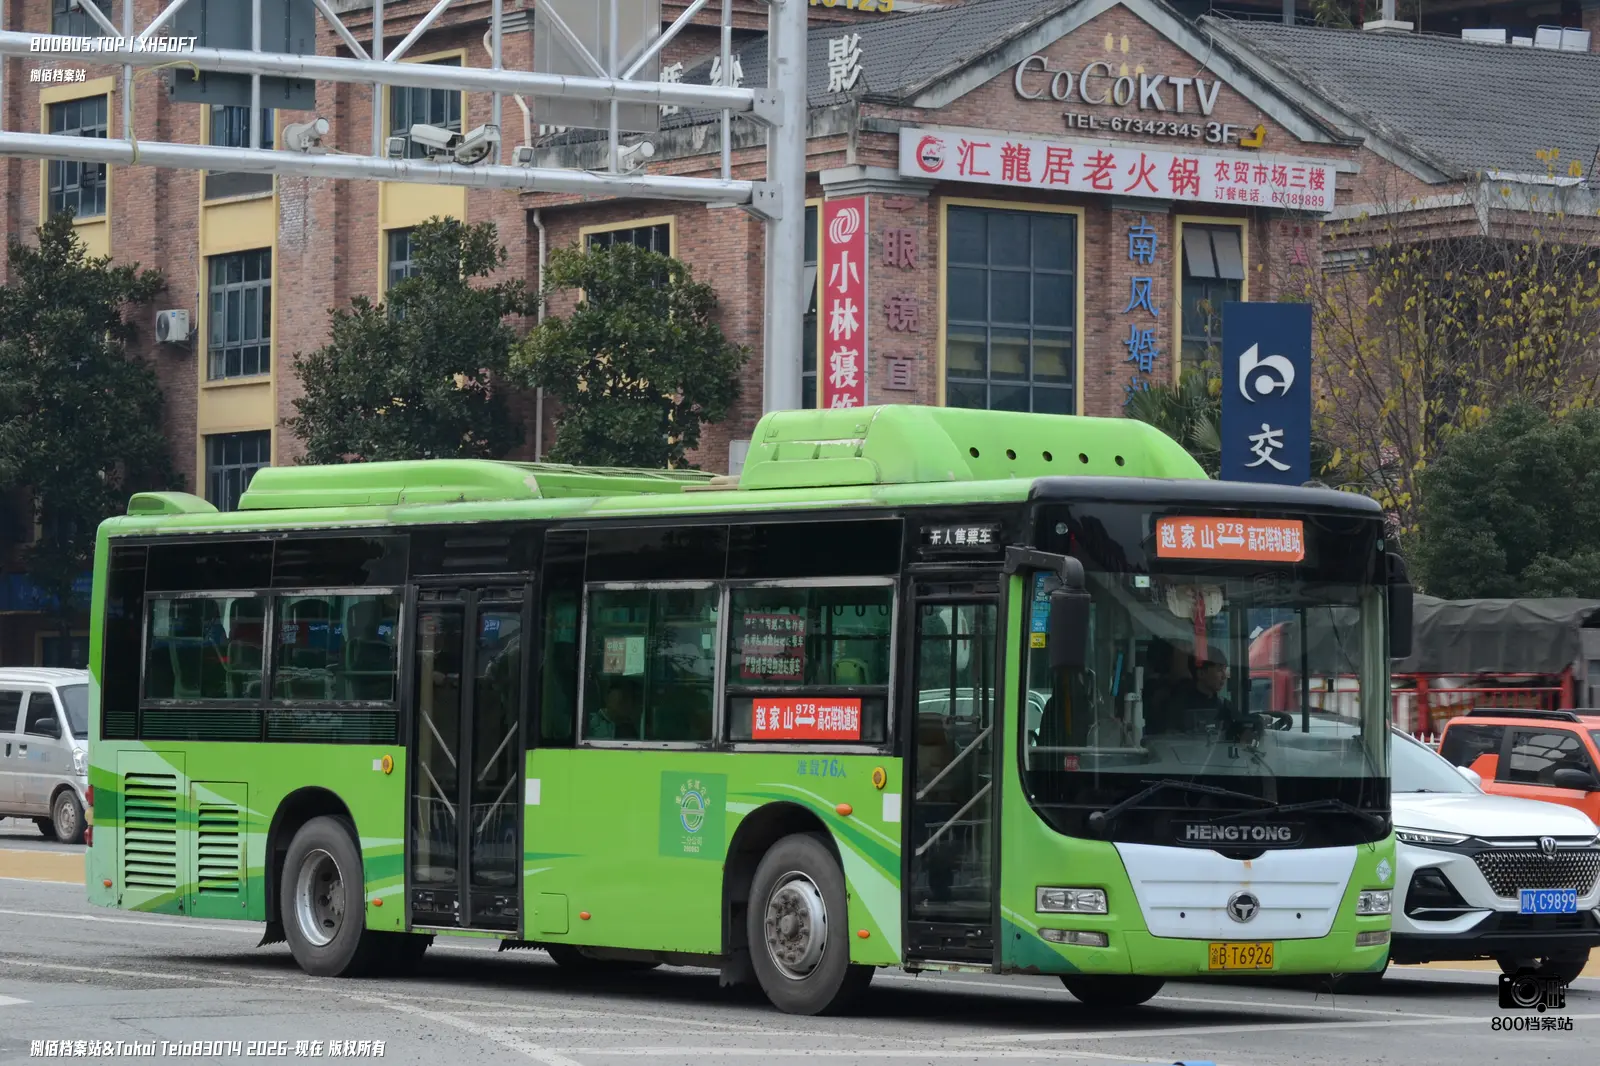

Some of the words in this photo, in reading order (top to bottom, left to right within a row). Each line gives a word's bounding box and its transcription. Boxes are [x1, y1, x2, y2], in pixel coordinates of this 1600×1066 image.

[1065, 112, 1201, 138] TEL-67342345
[1206, 121, 1239, 144] 3F
[956, 137, 1201, 197] 汇龍居老火锅
[1214, 160, 1325, 191] 农贸市场三楼
[1244, 423, 1292, 471] 交
[930, 527, 992, 547] 无人售票车
[1161, 523, 1215, 549] 赵家山
[1216, 523, 1244, 534] 978
[1247, 526, 1301, 553] 高石塔轨道站
[755, 705, 793, 731] 赵家山
[795, 703, 816, 715] 978
[817, 705, 859, 731] 高石塔轨道站
[1185, 824, 1292, 841] HENGTONG
